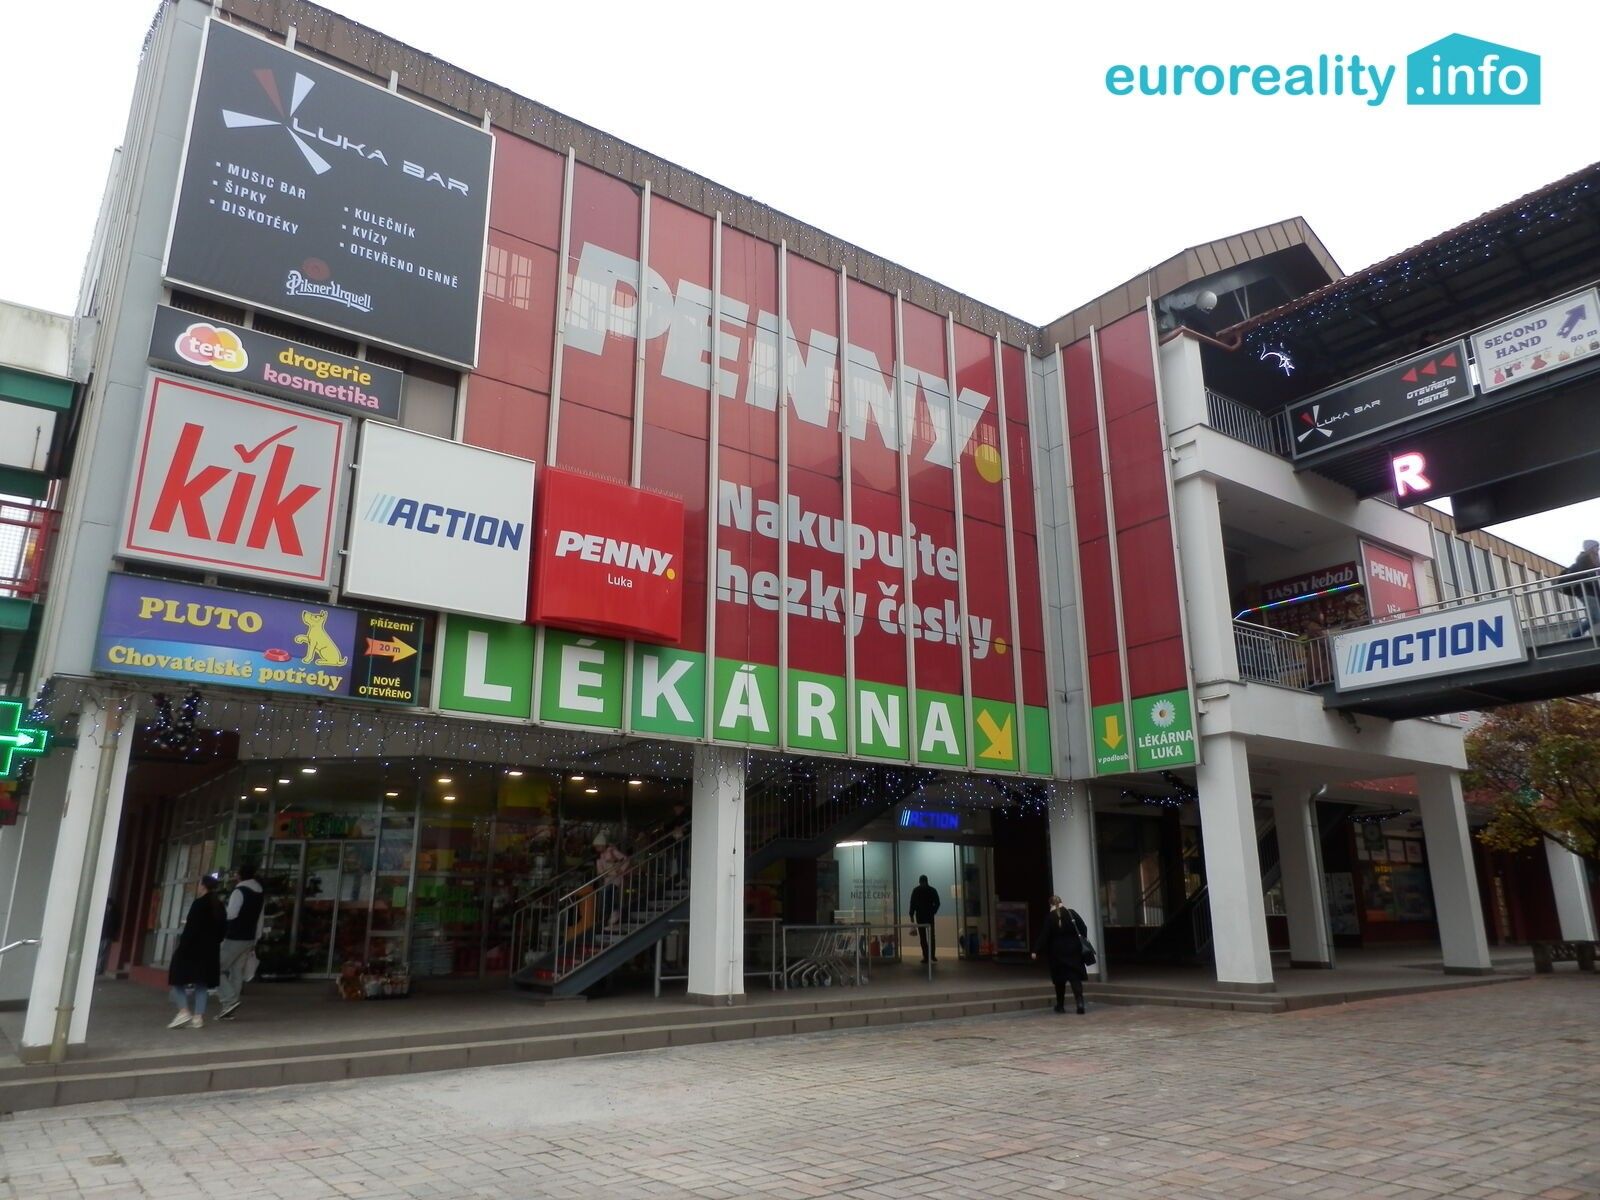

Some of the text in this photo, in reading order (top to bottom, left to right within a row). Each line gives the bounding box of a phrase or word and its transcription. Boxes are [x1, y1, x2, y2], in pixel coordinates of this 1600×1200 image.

[293, 117, 470, 197] LUKA BAR
[224, 180, 267, 205] ŠIPKY
[227, 163, 307, 200] MUSIC BAR
[221, 200, 299, 235] DISKOTÉKY
[354, 208, 416, 238] KULEČNÍK
[352, 225, 388, 247] KVÍZY
[350, 243, 459, 289] OTEVŘENO DENNĚ
[188, 334, 237, 363] teta
[1484, 318, 1548, 349] SECOND
[1495, 335, 1542, 359] HAND
[1570, 329, 1598, 343] 80 m
[279, 347, 371, 386] drogerie
[263, 363, 380, 410] kosmetika
[1316, 399, 1381, 428] LUKA BAR
[1393, 452, 1432, 497] R
[387, 498, 524, 551] ACTION
[718, 480, 960, 583] Nakupujte
[607, 573, 633, 589] Luka
[717, 548, 867, 637] hezky
[1266, 567, 1354, 600] TASTY kebab
[139, 596, 263, 633] PLUTO
[380, 643, 390, 652] 20
[1365, 615, 1504, 672] ACTION
[108, 645, 343, 691] Chovatelské potřeby
[373, 675, 401, 687] NOVĚ
[359, 685, 412, 699] OTEVŘENO
[463, 631, 960, 756] LÉKÁRNA
[1138, 729, 1194, 748] LÉKÁRNA
[1151, 745, 1183, 760] LUKA
[910, 810, 959, 830] ACTION
